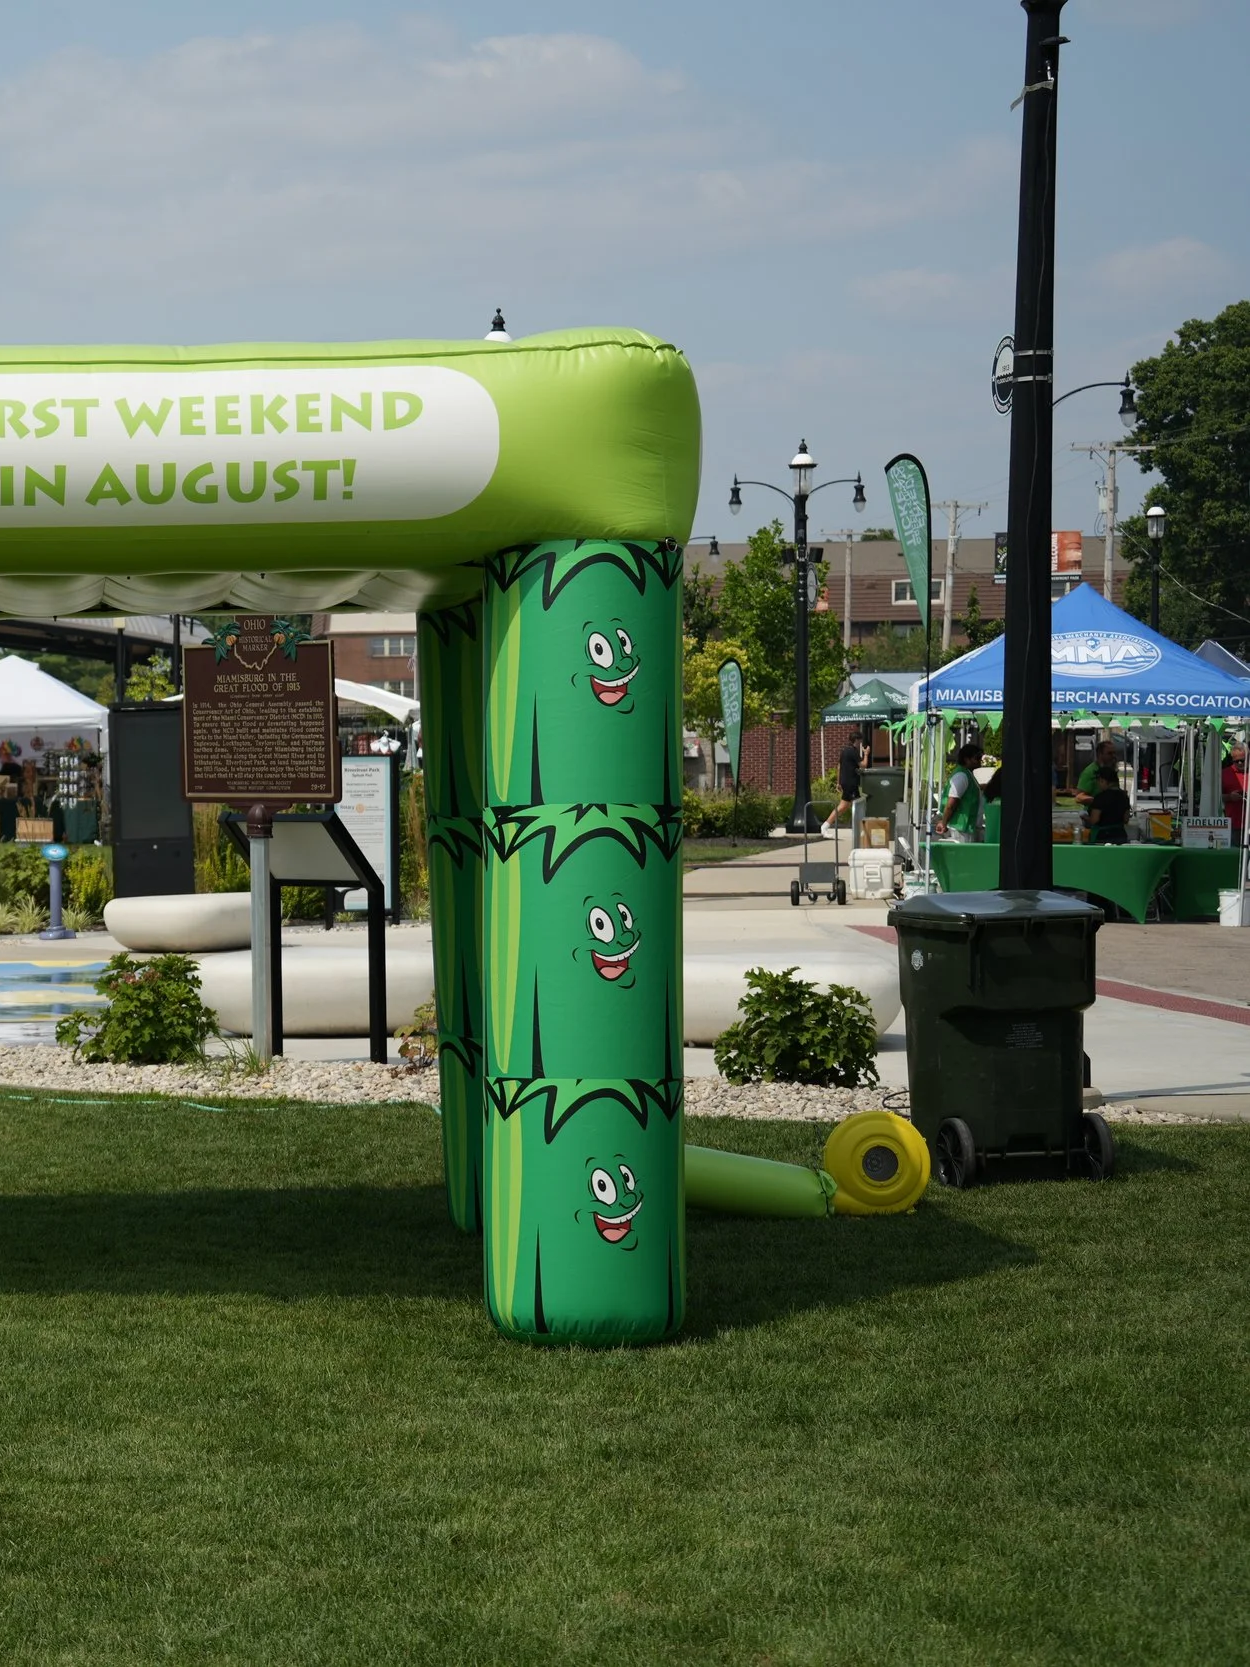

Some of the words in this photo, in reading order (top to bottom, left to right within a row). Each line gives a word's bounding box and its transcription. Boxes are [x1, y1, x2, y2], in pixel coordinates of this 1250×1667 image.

[114, 390, 423, 440] WEEKEND
[0, 464, 67, 507] IN
[84, 458, 357, 507] AUGUST!
[243, 618, 266, 630] OHIO
[238, 635, 272, 643] HISTORICAL
[216, 673, 264, 683] MIAMISBURG
[268, 673, 277, 682] IN
[280, 672, 297, 682] THE
[213, 684, 239, 693] GREAT
[242, 683, 268, 692] FLOOD
[272, 682, 283, 691] OF
[286, 682, 301, 691] 1913
[936, 689, 1003, 702] MIAMISB
[1145, 693, 1250, 708] ASSOCIATION
